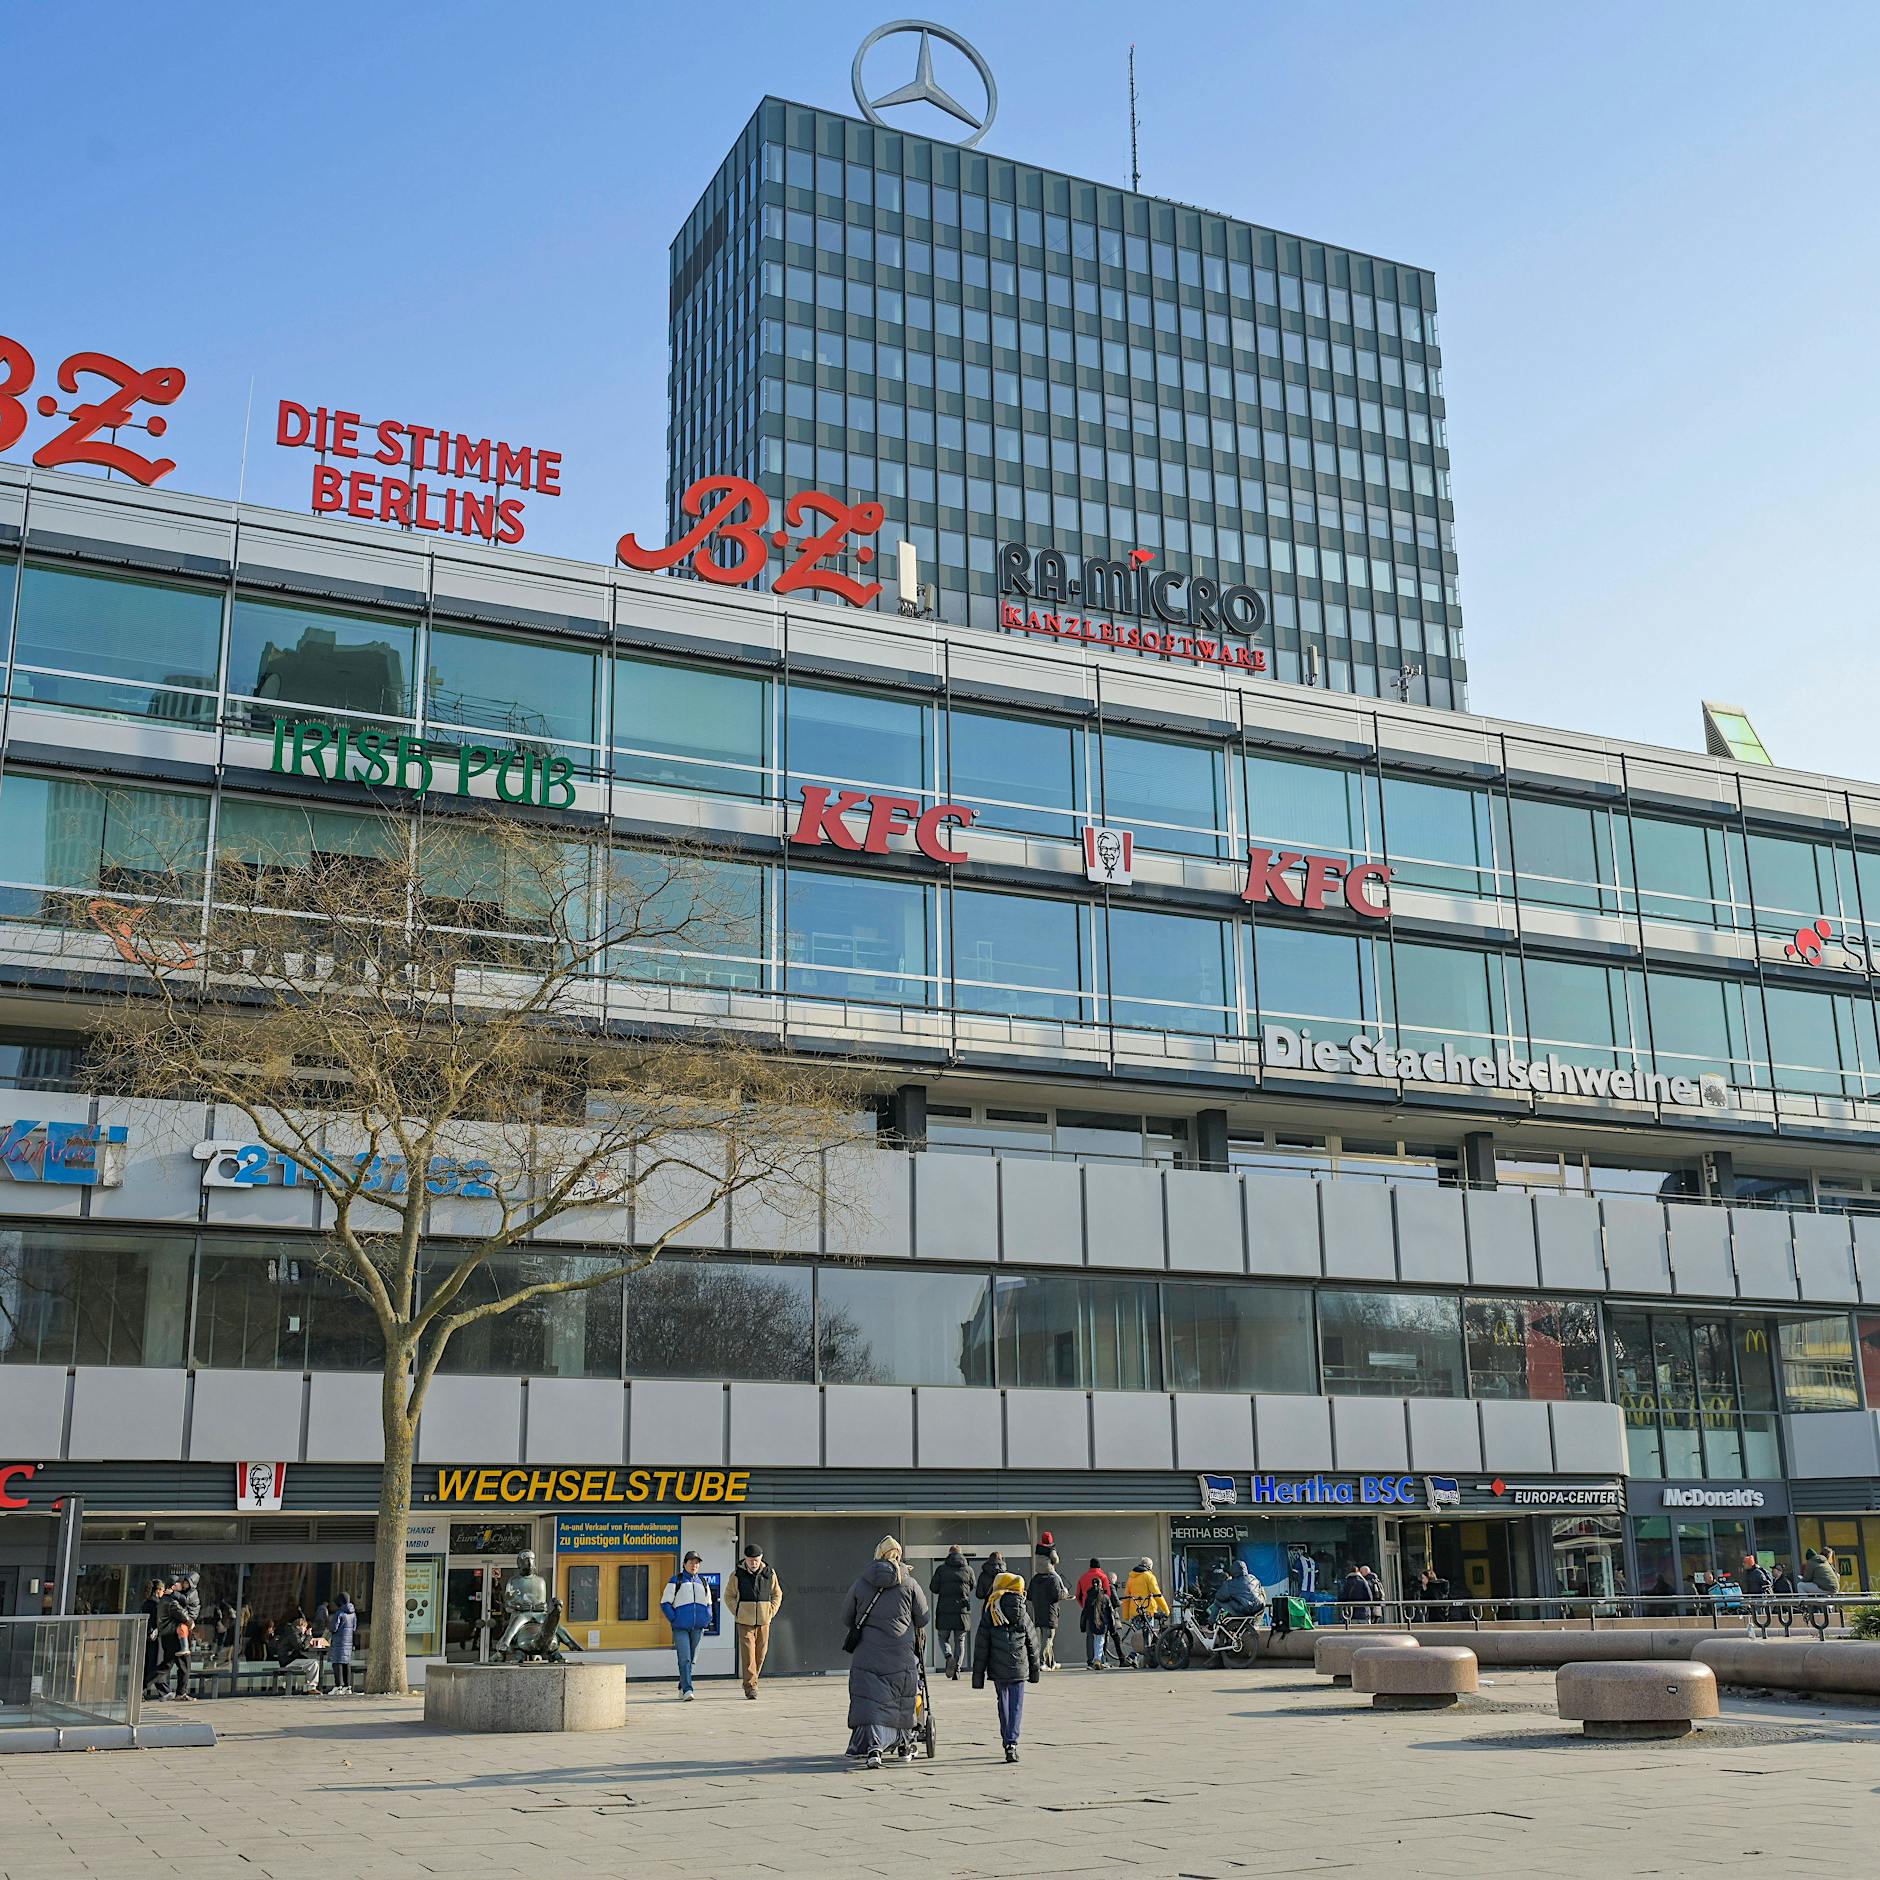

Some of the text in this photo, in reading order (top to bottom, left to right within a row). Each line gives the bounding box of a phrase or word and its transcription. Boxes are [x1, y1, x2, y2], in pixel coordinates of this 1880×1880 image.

[276, 400, 562, 496] DIE STIMME
[312, 464, 525, 545] BERLINS
[1005, 604, 1267, 669] KANZLEISOFTWARE
[269, 717, 577, 811] IRISH PUB
[790, 785, 973, 865] KFC
[1242, 847, 1394, 919] KFC
[1263, 1024, 1694, 1107] Die Stachelschweine
[438, 1470, 750, 1501] WECHSELSTUBE
[1251, 1474, 1415, 1504] Hertha BSC
[1514, 1491, 1616, 1504] EUROPA-CENTER
[1663, 1488, 1765, 1507] McDonald's
[560, 1533, 679, 1548] zu günstigen Konditionen
[585, 1522, 610, 1531] Verkauf
[623, 1522, 679, 1532] Fremdwährungen
[1170, 1527, 1211, 1539] HERTHA
[1214, 1527, 1234, 1538] BSC
